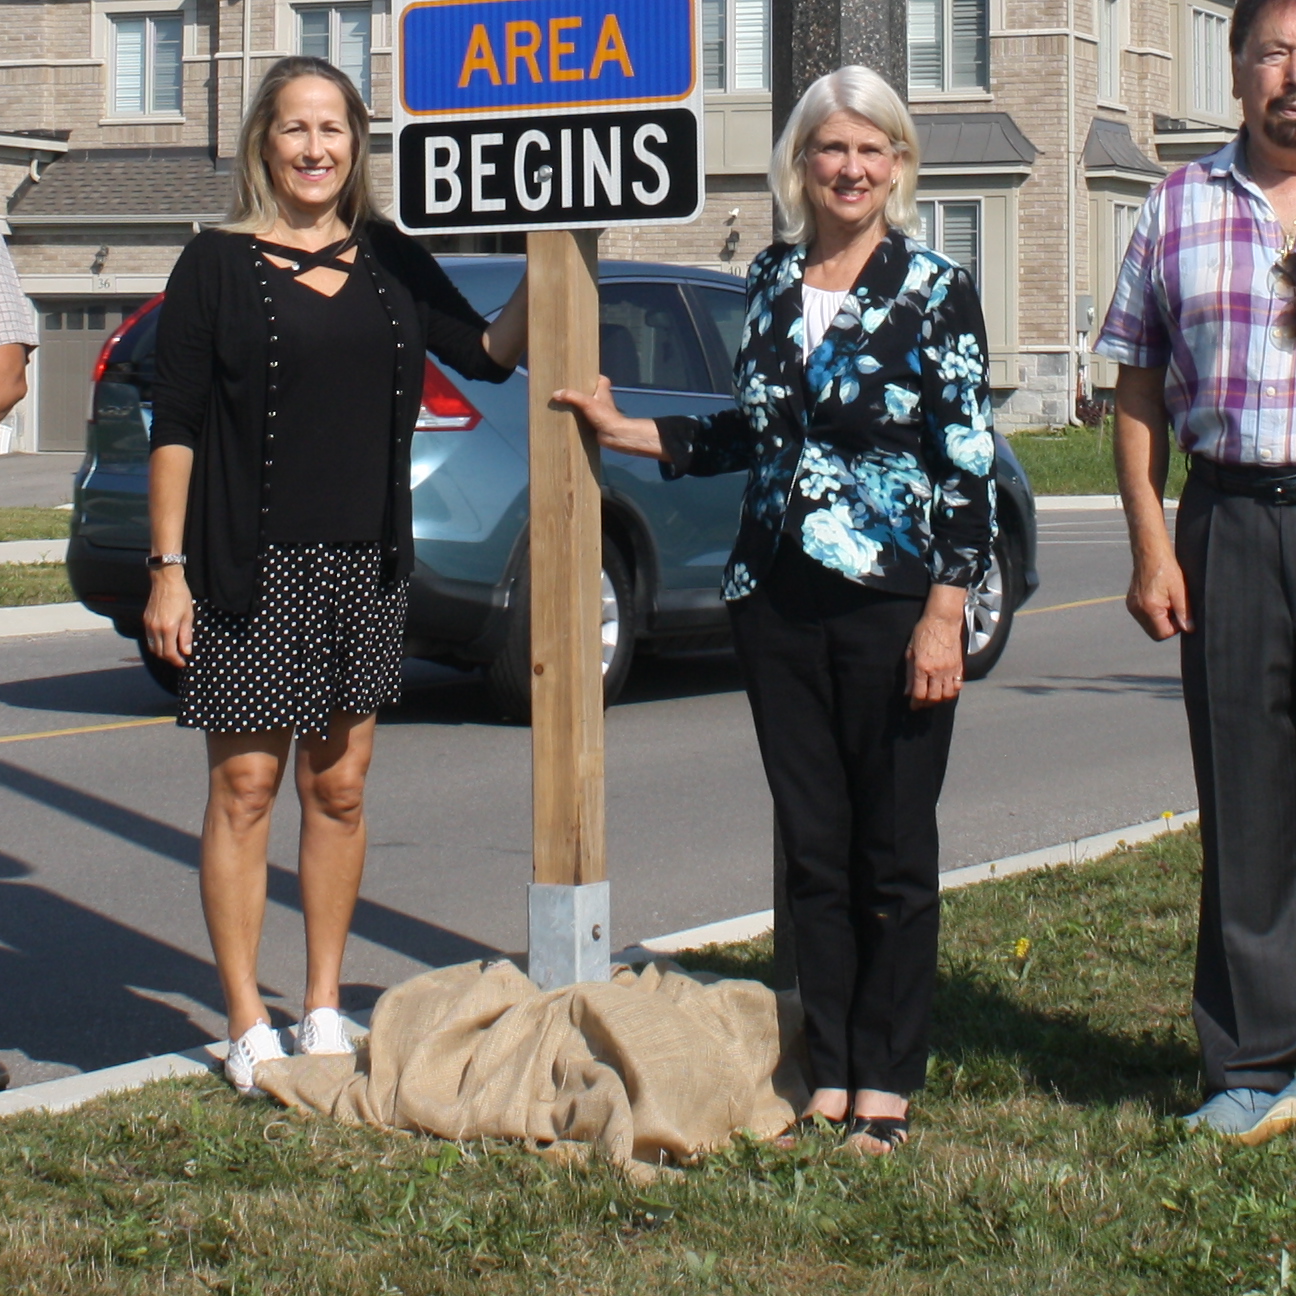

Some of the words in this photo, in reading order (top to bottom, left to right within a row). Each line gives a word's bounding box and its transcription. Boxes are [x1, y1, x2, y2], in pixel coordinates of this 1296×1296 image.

[457, 13, 635, 89] AREA
[425, 122, 671, 215] BEGINS
[98, 278, 111, 289] 36
